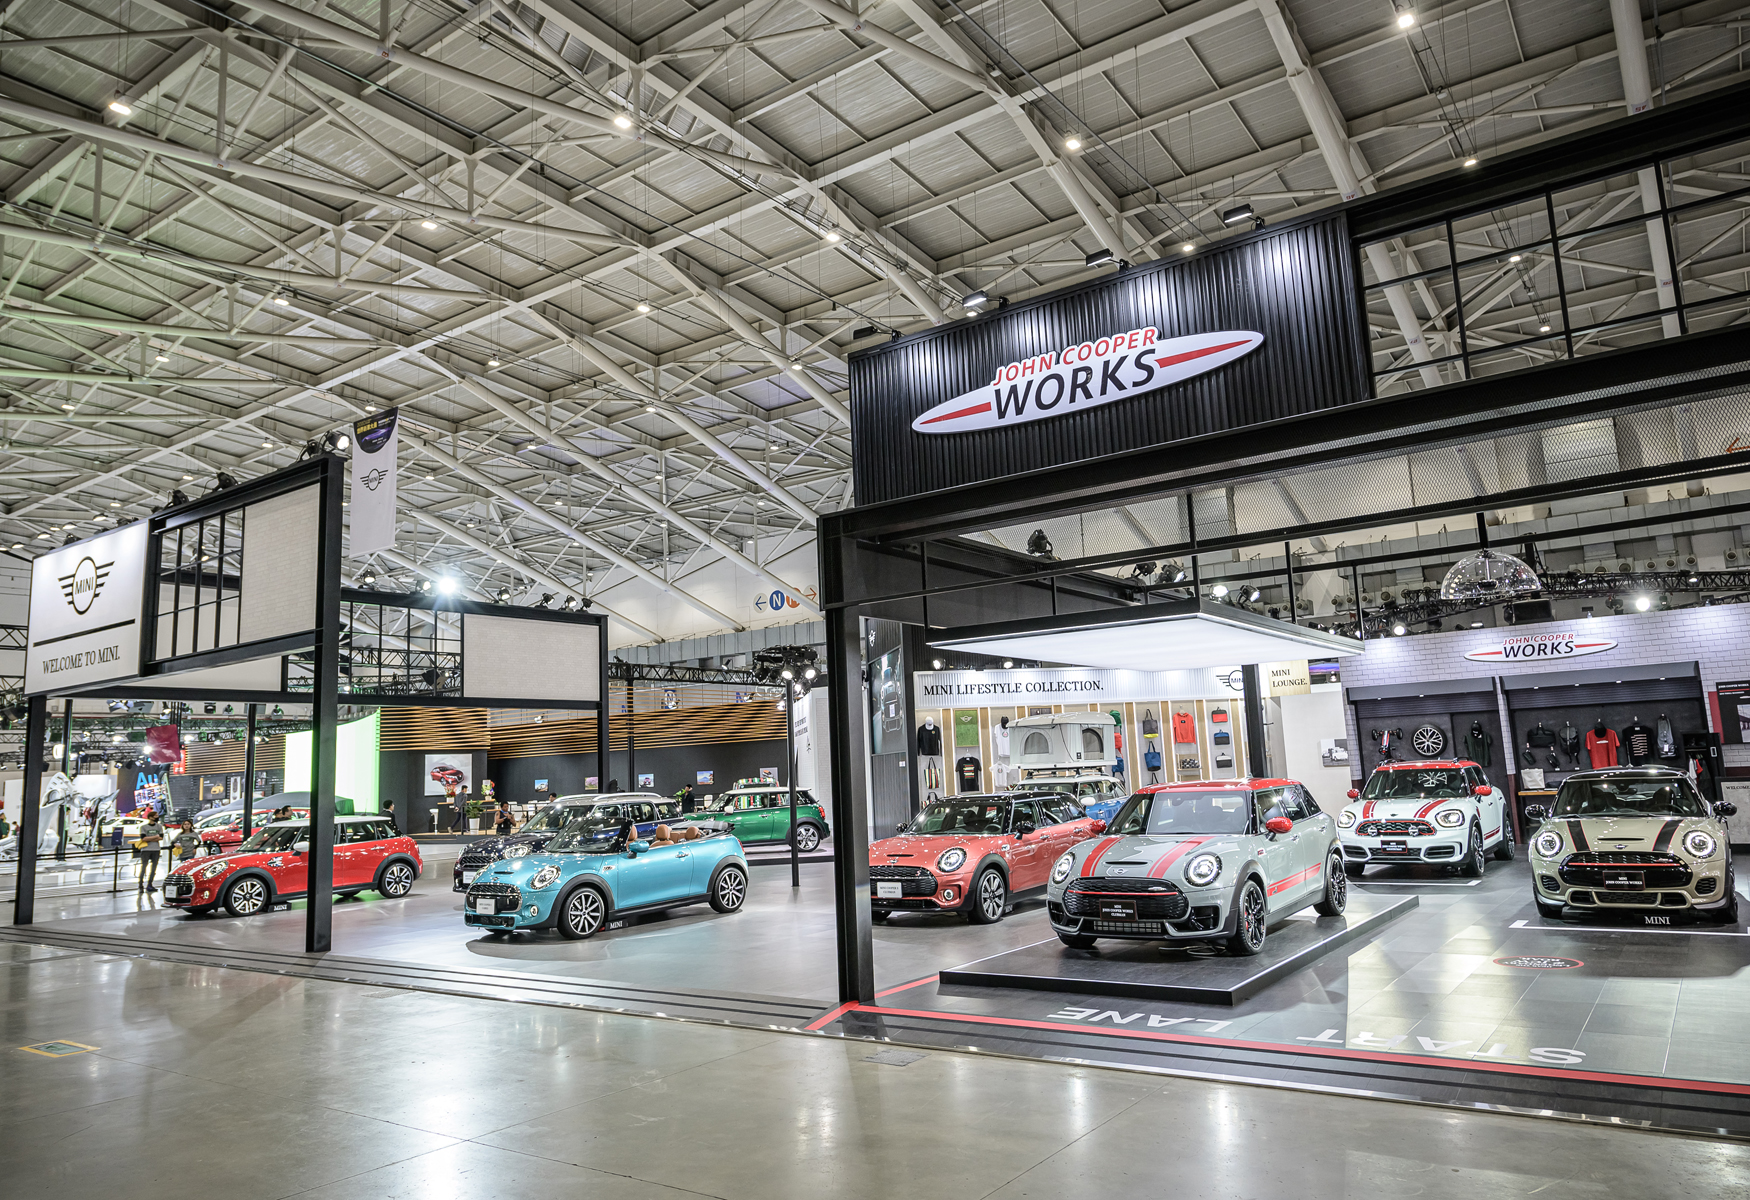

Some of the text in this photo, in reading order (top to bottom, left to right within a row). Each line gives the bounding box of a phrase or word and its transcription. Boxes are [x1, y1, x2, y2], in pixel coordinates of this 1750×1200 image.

[993, 328, 1155, 386] JOHN COOPER
[994, 349, 1156, 420] WORKS
[74, 576, 94, 595] MINI
[1503, 633, 1575, 646] JOHN COOPER
[1503, 640, 1574, 658] WORKS
[42, 645, 120, 675] WELCOME TO MINI.
[1271, 668, 1291, 677] MINI
[923, 680, 1104, 696] MINI LIFESTYLE COLLECTION.
[1272, 678, 1308, 688] LOUNGE.
[273, 904, 288, 912] MINI
[609, 920, 623, 929] MINI
[1644, 915, 1671, 925] MINI
[1046, 1006, 1587, 1065] START LANE
